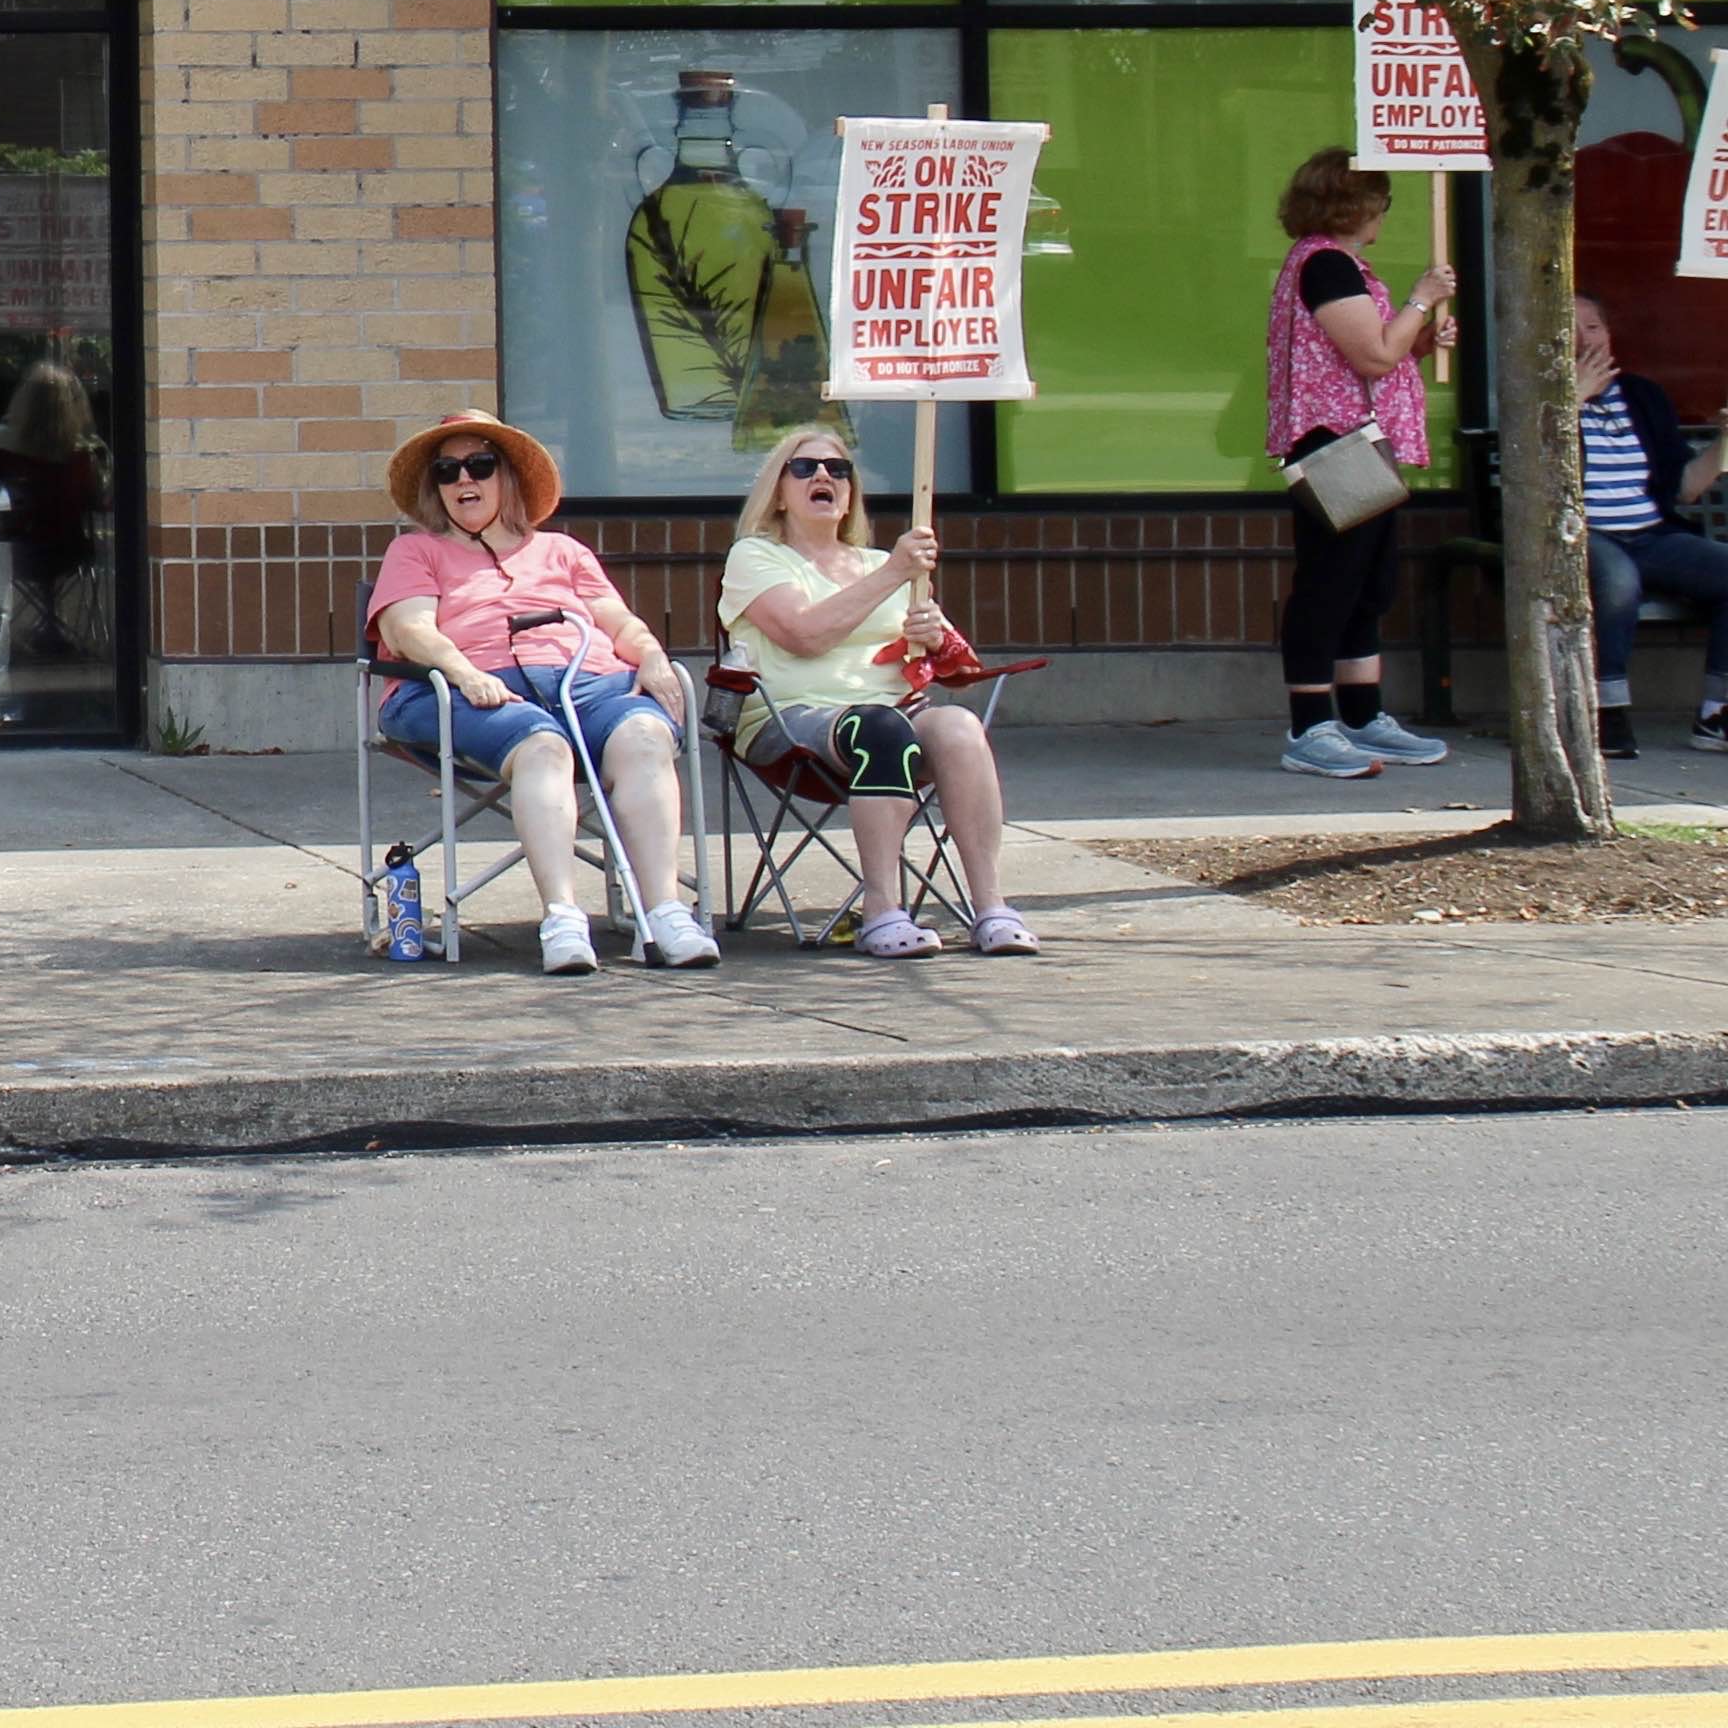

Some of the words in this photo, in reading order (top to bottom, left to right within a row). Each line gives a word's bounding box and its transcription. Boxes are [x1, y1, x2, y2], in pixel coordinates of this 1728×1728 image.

[1375, 1, 1456, 35] STR
[1372, 64, 1480, 97] UNFA
[1373, 104, 1486, 127] EMPLOYE
[861, 139, 883, 150] NEW
[888, 139, 937, 151] SEASONS
[944, 138, 976, 150] LABOR
[981, 139, 1014, 150] UNION
[1394, 140, 1407, 149] DO
[1411, 140, 1429, 149] NOT
[914, 156, 956, 187] ON
[858, 192, 1001, 235] STRIKE
[853, 267, 993, 311] UNFAIR
[853, 317, 997, 348] EMPLOYER
[878, 364, 892, 375] DO
[896, 363, 918, 374] NOT
[923, 362, 980, 374] PATRONIZE
